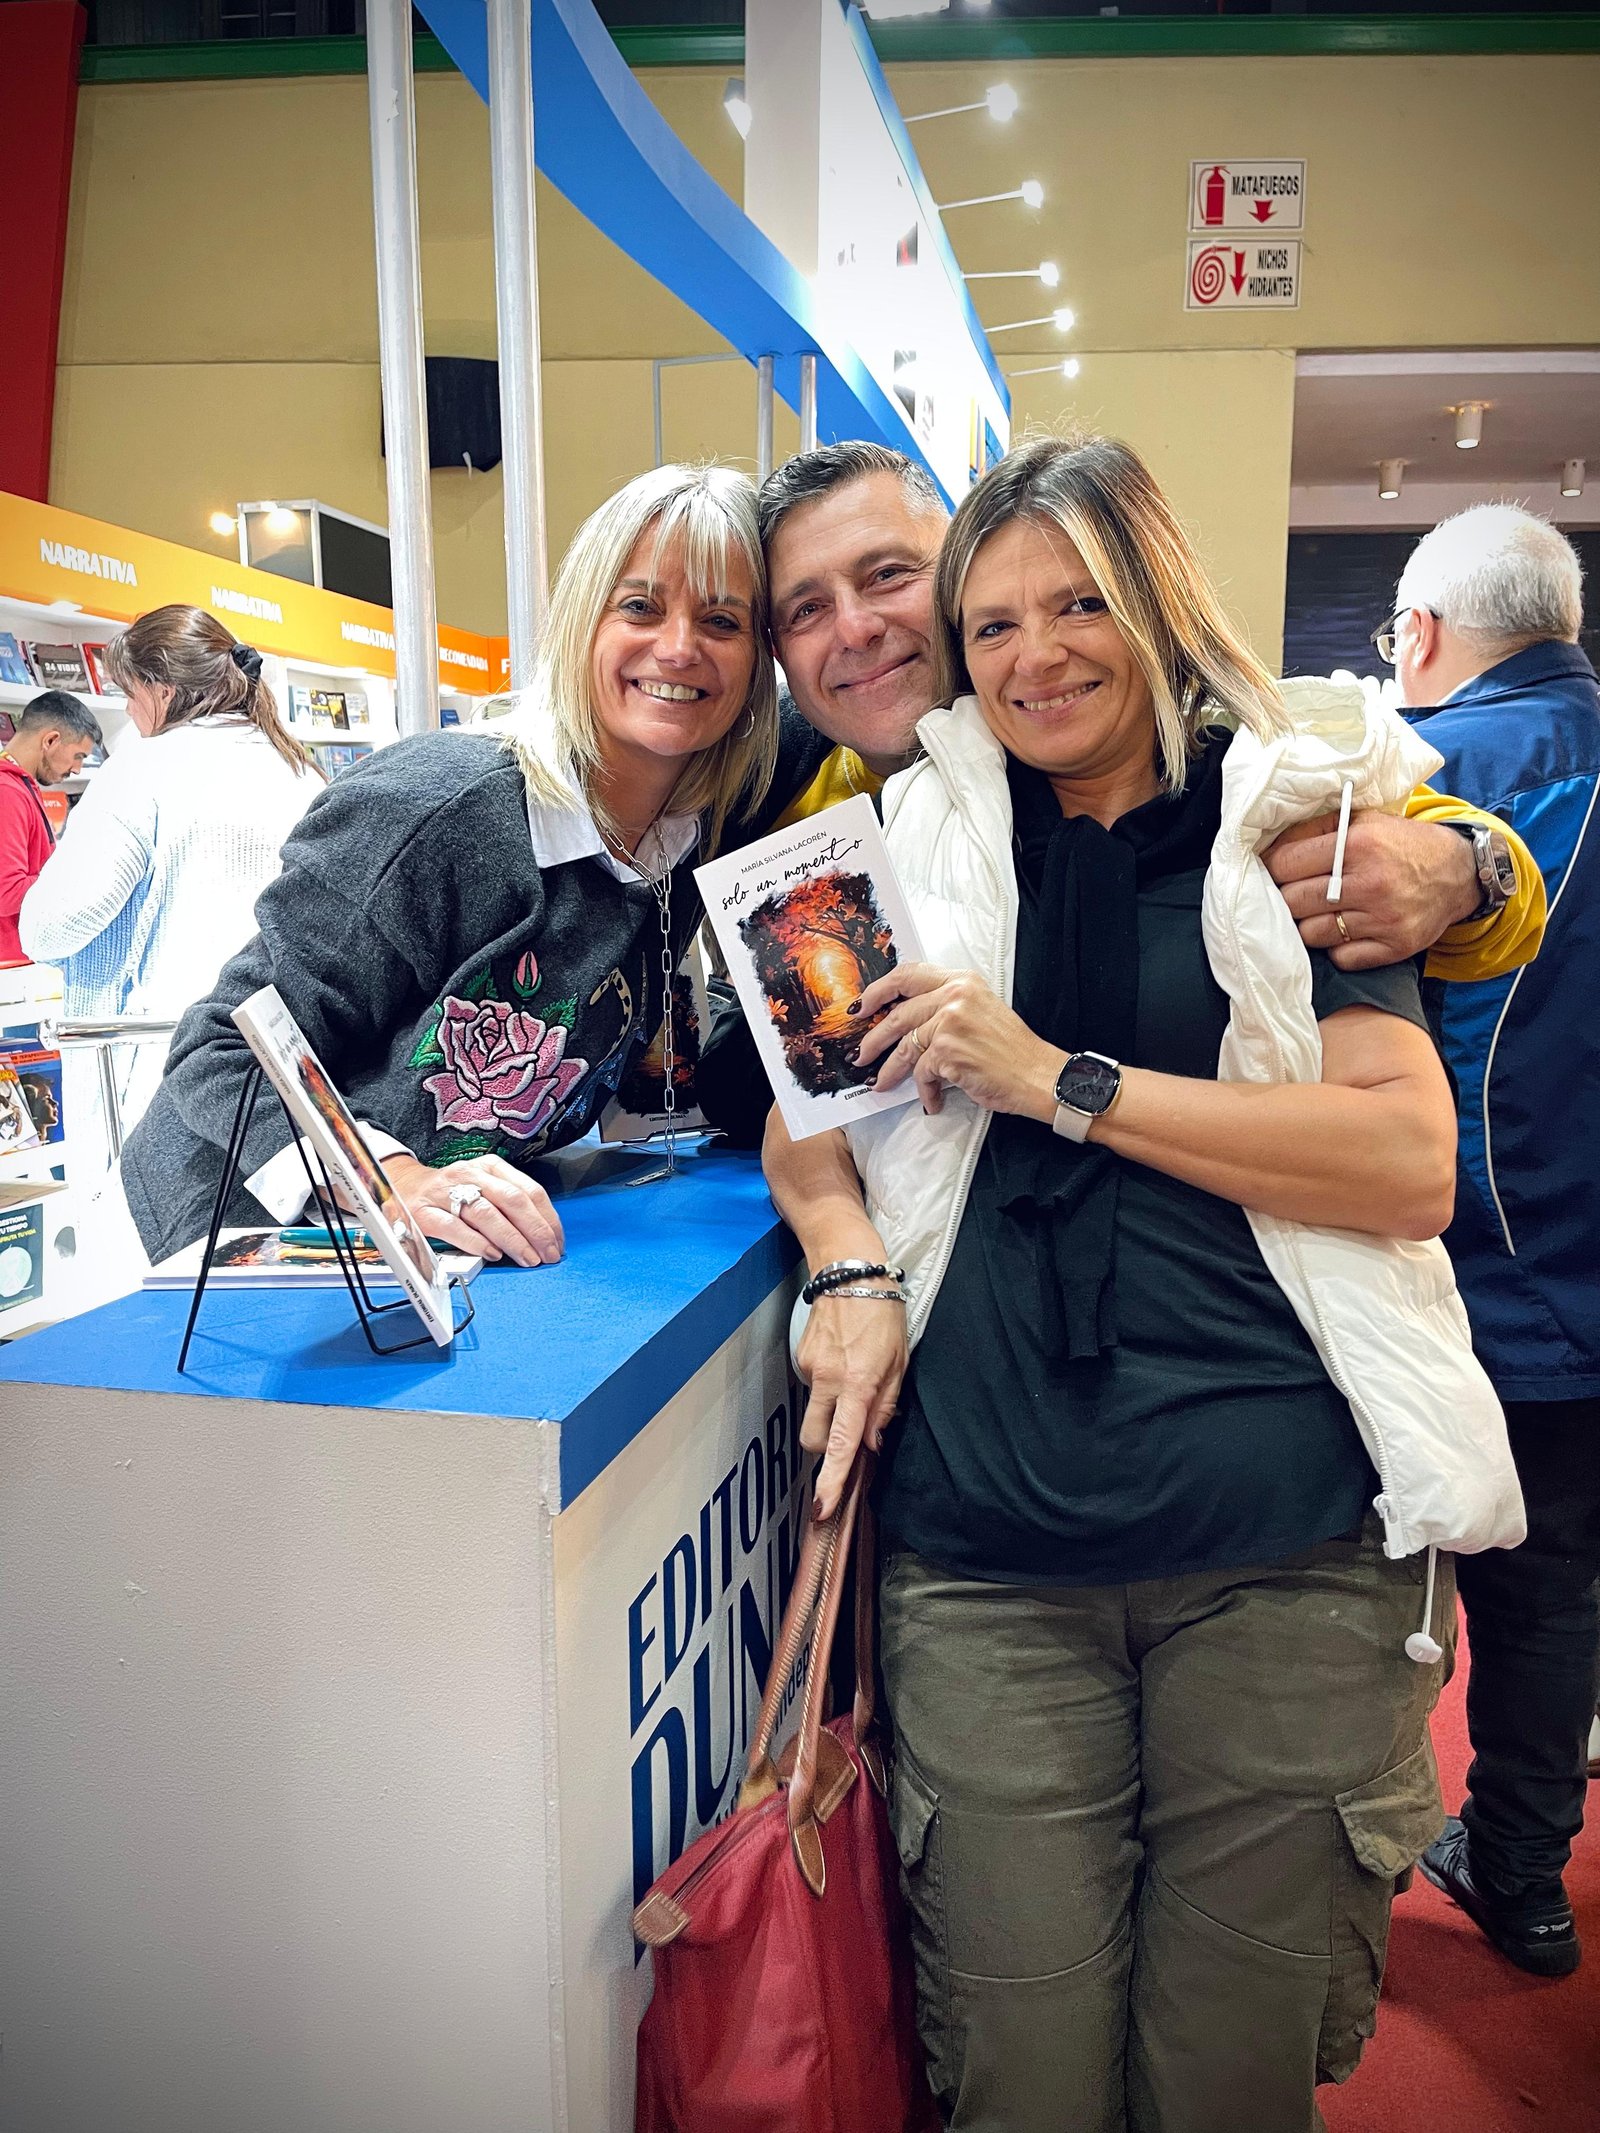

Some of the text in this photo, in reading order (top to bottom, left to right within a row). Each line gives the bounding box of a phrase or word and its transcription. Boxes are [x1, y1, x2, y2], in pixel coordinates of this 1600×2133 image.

[1231, 175, 1299, 196] MATAFUEGOS
[1257, 249, 1288, 270] NICHOS
[1248, 276, 1293, 297] HIDRANTES
[39, 538, 138, 587] NARRATIVA
[211, 585, 283, 624] NARRATIVA
[340, 621, 396, 652] NARRATIVA
[741, 830, 828, 875] MARÍA SILVANA LACORÉN
[721, 881, 750, 911] solo
[756, 878, 778, 893] un
[629, 1381, 811, 1740] EDITORI
